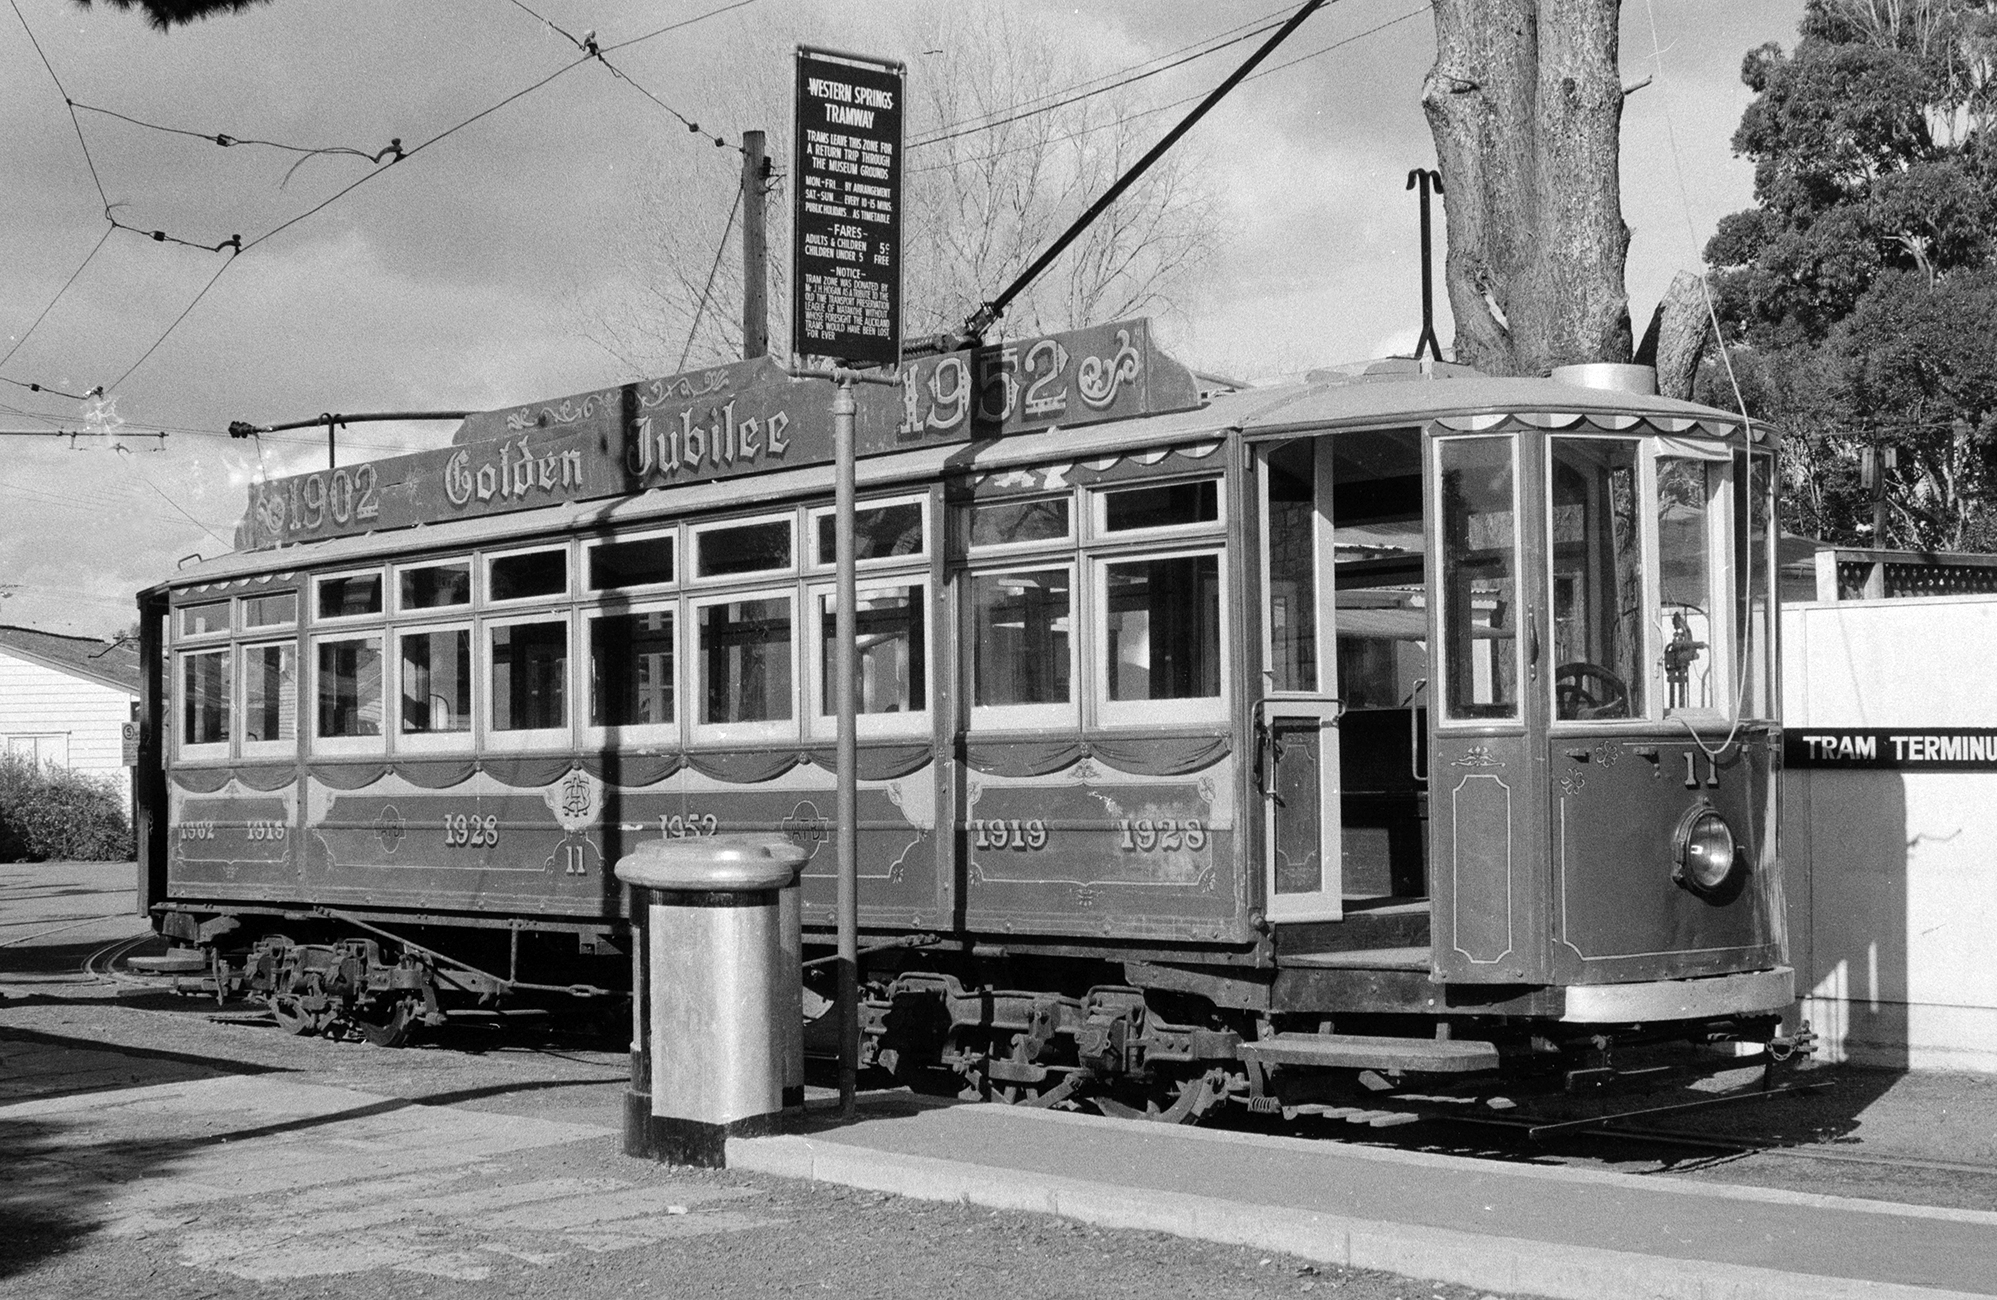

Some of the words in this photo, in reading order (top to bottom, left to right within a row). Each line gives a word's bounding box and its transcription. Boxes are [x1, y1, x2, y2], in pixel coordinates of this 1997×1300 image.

[808, 78, 852, 103] WESTERN
[854, 86, 893, 109] SPRINGS
[825, 103, 875, 129] TRAMWAY
[807, 129, 829, 144] TRAMS
[831, 133, 847, 147] LEAVE
[849, 136, 861, 149] THIS
[863, 139, 879, 152] ZONE
[880, 142, 892, 155] FOR
[807, 142, 813, 155] A
[815, 144, 842, 159] RETURN
[844, 148, 859, 161] TRIP
[861, 151, 890, 167] THROUGH
[812, 156, 826, 170] THE
[829, 159, 858, 175] MUSEUM
[860, 165, 888, 180] GROUNDS
[844, 194, 860, 206] EVERY
[845, 181, 852, 192] BY
[853, 183, 891, 198] ARRANGEMENT
[805, 202, 823, 214] PUBLIC
[823, 204, 847, 217] HOLIDAYS
[853, 209, 860, 219] AS
[861, 210, 890, 224] TIMETABLE
[805, 233, 828, 246] ADULTS
[830, 237, 835, 247] &
[837, 238, 867, 252] CHILDREN
[805, 244, 834, 258] CHILDREN
[836, 249, 856, 261] UNDER
[859, 252, 863, 262] 5
[874, 254, 889, 266] FREE
[805, 273, 821, 284] TRAM
[823, 275, 838, 287] ZONE
[840, 278, 852, 289] WAS
[853, 279, 879, 291] DONATED
[880, 282, 889, 292] BY
[823, 285, 841, 295] HOGAN
[842, 287, 848, 297] AS
[853, 288, 871, 300] TRIBUTE
[872, 290, 878, 300] TO
[880, 291, 889, 302] THE
[805, 292, 815, 302] OLD
[816, 293, 827, 303] TIME
[828, 294, 855, 306] TRANSPORT
[856, 298, 890, 311] PRESERVATION
[805, 301, 825, 312] LEAGUE
[827, 303, 835, 313] OF
[865, 308, 887, 319] WITHOUT
[805, 310, 824, 321] WHOSE
[825, 312, 851, 324] FORESIGHT
[853, 315, 863, 325] THE
[864, 317, 890, 329] AUCKLAND
[805, 320, 823, 330] TRAMS
[825, 321, 845, 332] WOULD
[847, 324, 861, 334] HAVE
[863, 326, 876, 336] BEEN
[807, 329, 819, 339] FOR
[821, 330, 835, 341] EVER
[899, 339, 1070, 434] 1952
[289, 462, 379, 531] 1902
[443, 435, 583, 505] Golden
[627, 393, 792, 477] Jubilee
[1802, 736, 1876, 760] TRAM
[1683, 751, 1721, 788] 11
[247, 820, 285, 840] 1919
[444, 813, 498, 849] 1928
[974, 818, 1048, 850] 1919
[1120, 817, 1206, 850] 1928
[566, 845, 586, 875] 11
